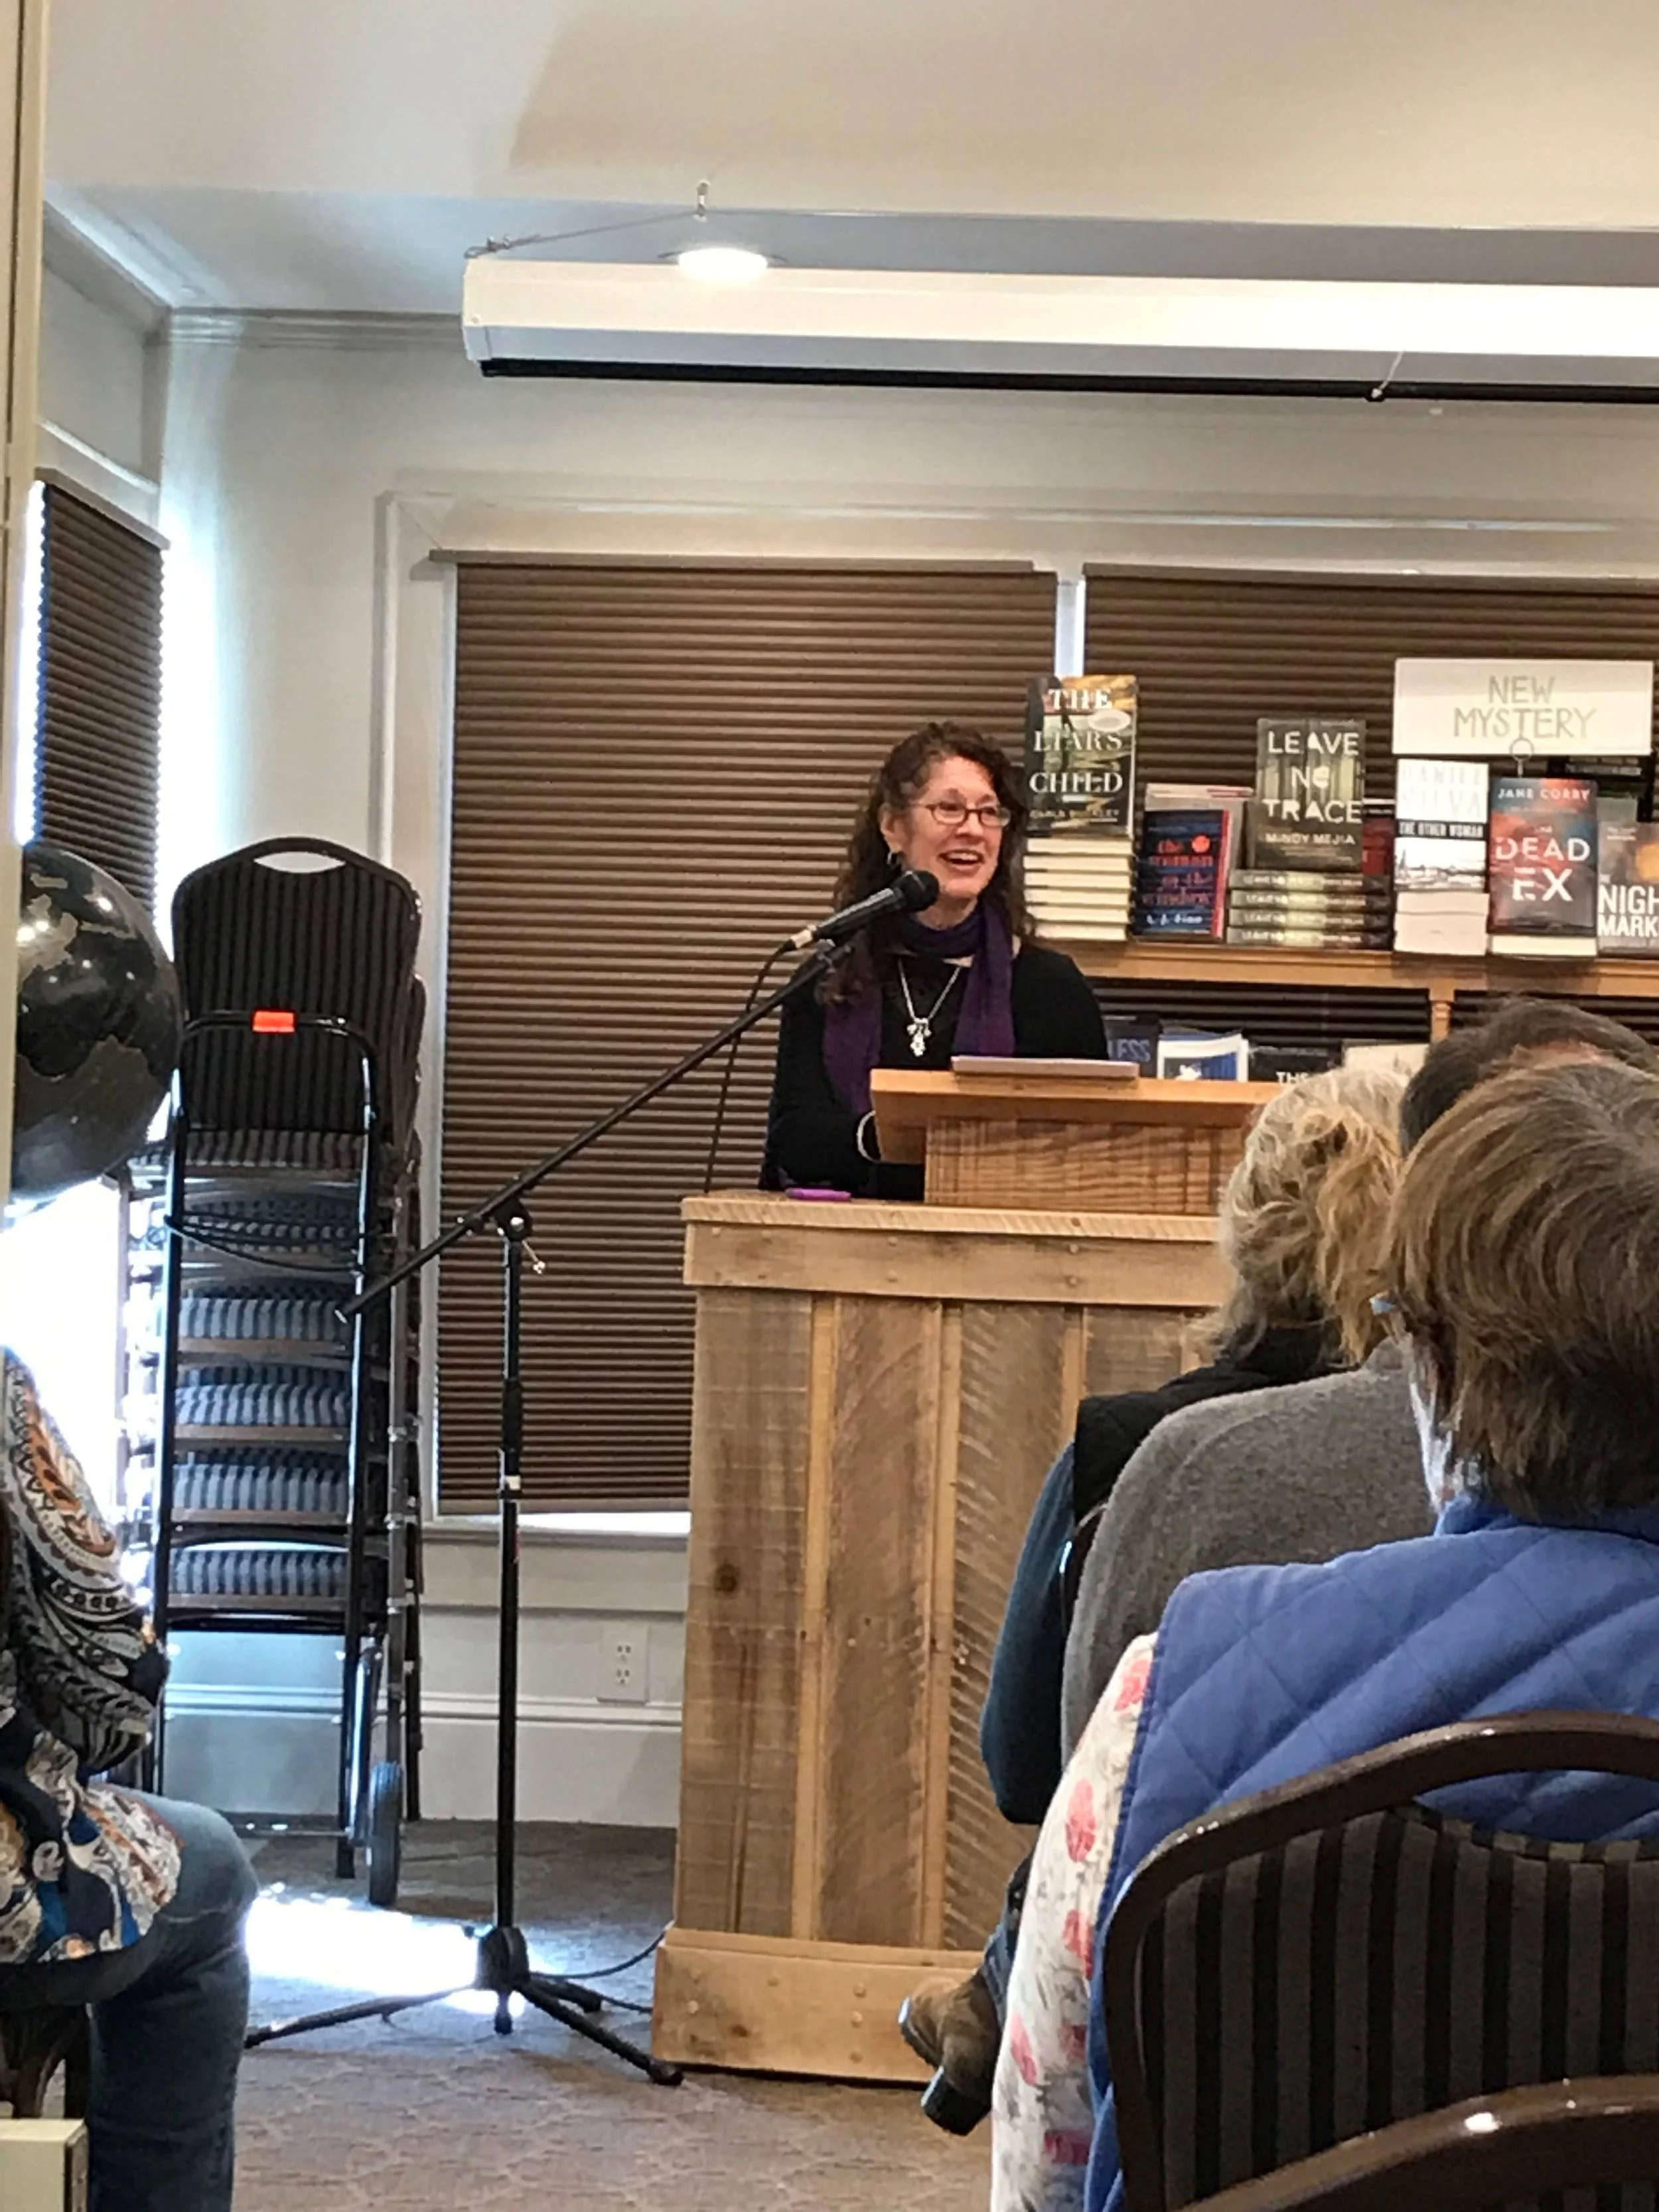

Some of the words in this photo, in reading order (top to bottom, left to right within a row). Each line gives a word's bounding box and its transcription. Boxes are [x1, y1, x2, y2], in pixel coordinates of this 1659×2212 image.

[1048, 688, 1112, 710] THE
[1488, 675, 1555, 704] NEW
[1453, 707, 1597, 739] MYSTERY
[1268, 731, 1359, 755] LEAVE
[1029, 772, 1123, 793] CHILD
[1291, 765, 1330, 794] NO
[1498, 788, 1534, 799] JANE
[1540, 788, 1590, 800] CORRY
[1262, 799, 1362, 824] TRACE
[1265, 834, 1309, 844] MINDY
[1313, 834, 1355, 845] MEJIA
[1399, 821, 1415, 835] THE
[1495, 838, 1591, 861] DEAD
[1512, 867, 1573, 901] EX
